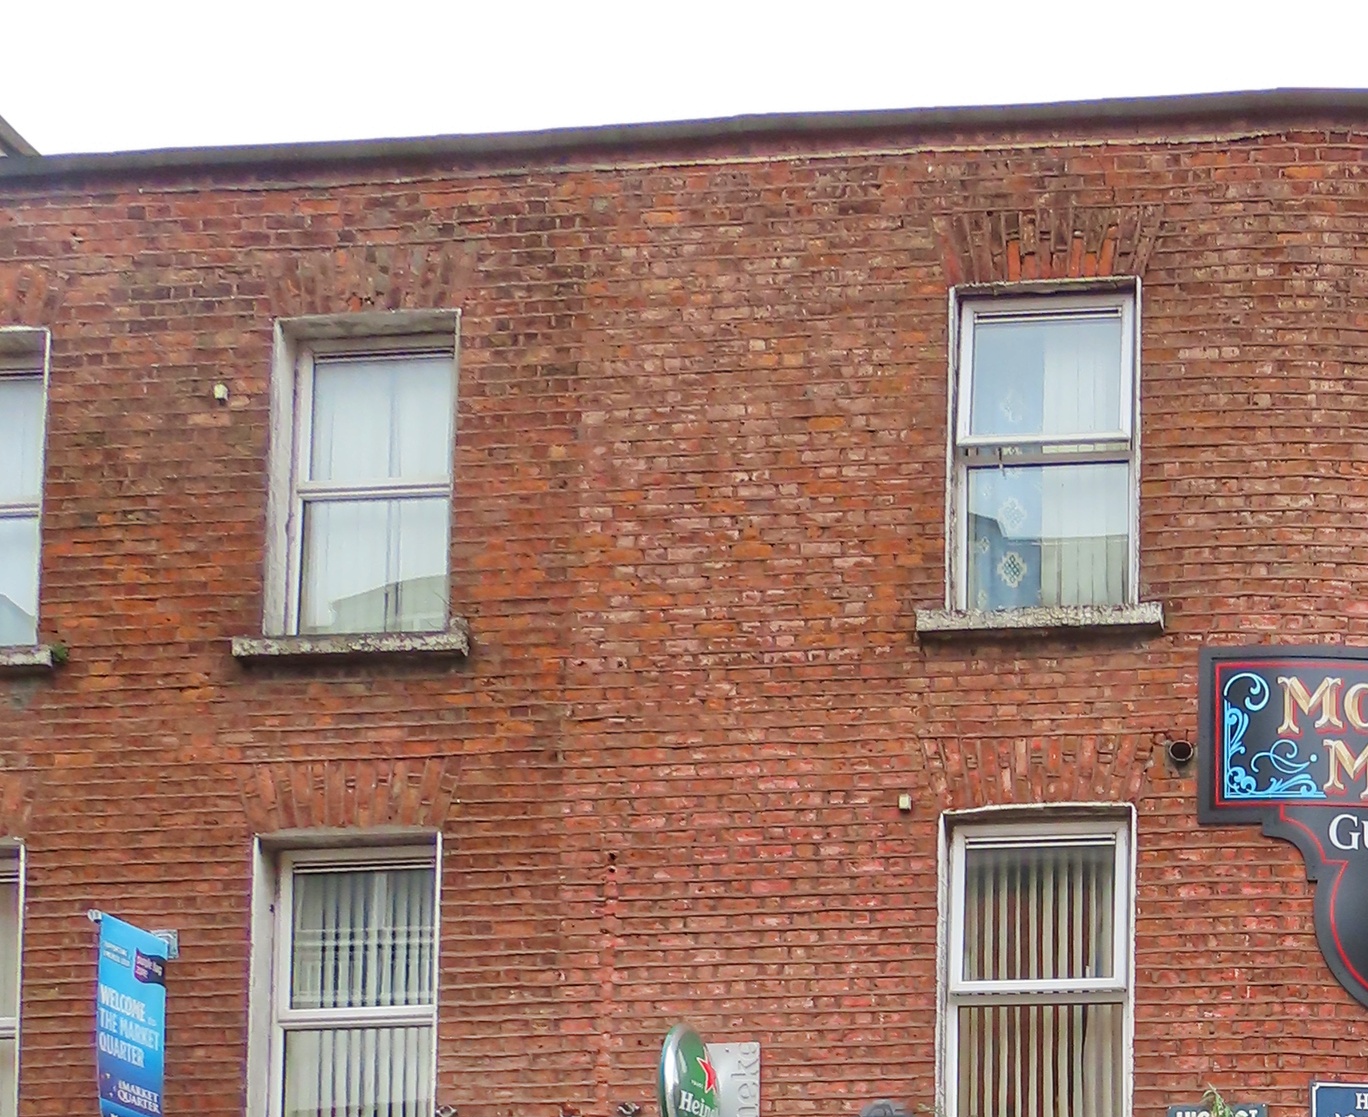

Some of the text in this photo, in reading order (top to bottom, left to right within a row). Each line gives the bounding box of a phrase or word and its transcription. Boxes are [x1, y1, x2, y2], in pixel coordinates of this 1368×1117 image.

[99, 984, 146, 1022] WELCOME
[99, 1008, 159, 1051] THE MARKET
[99, 1032, 145, 1068] QUARTER
[117, 1090, 161, 1115] QUARTER
